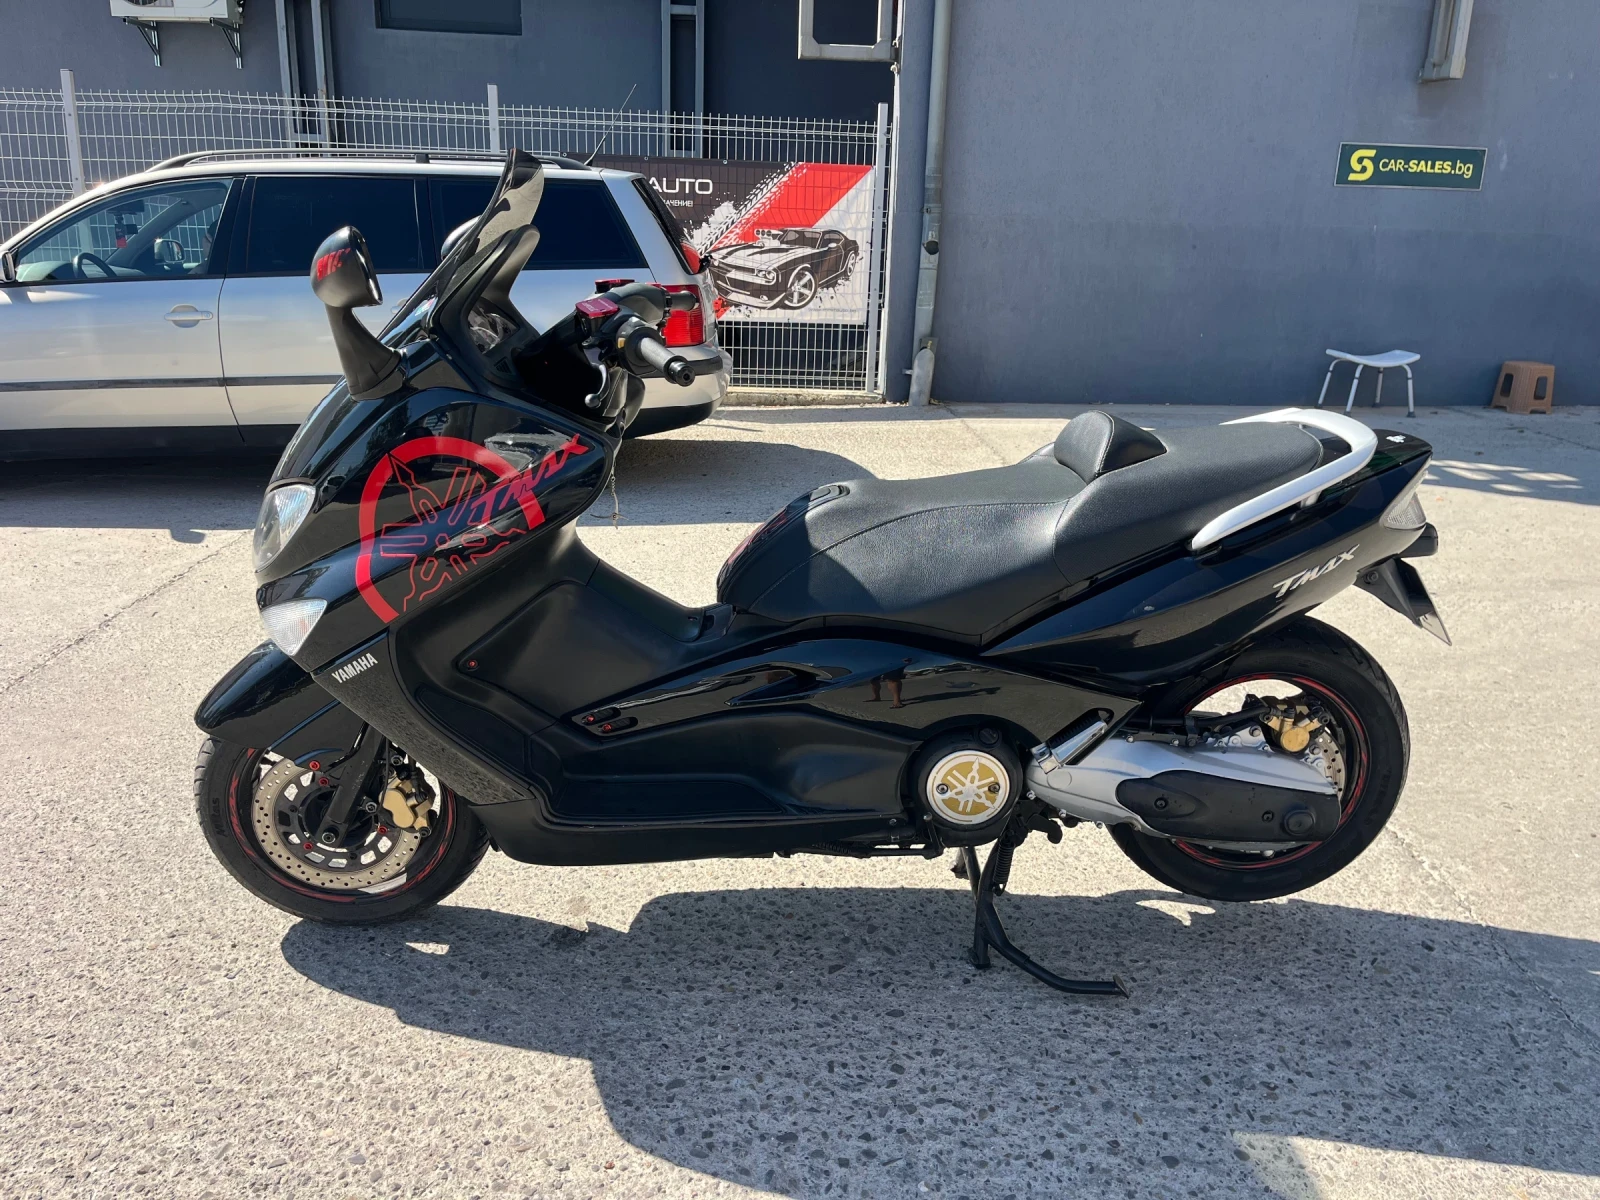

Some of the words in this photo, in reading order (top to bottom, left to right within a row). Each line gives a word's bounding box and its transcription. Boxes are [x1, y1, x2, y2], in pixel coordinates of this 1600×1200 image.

[1379, 158, 1474, 179] CAR-SALES.bg
[649, 176, 713, 195] AUTO
[1272, 543, 1360, 599] TMAX
[331, 652, 379, 684] YAMAHA
